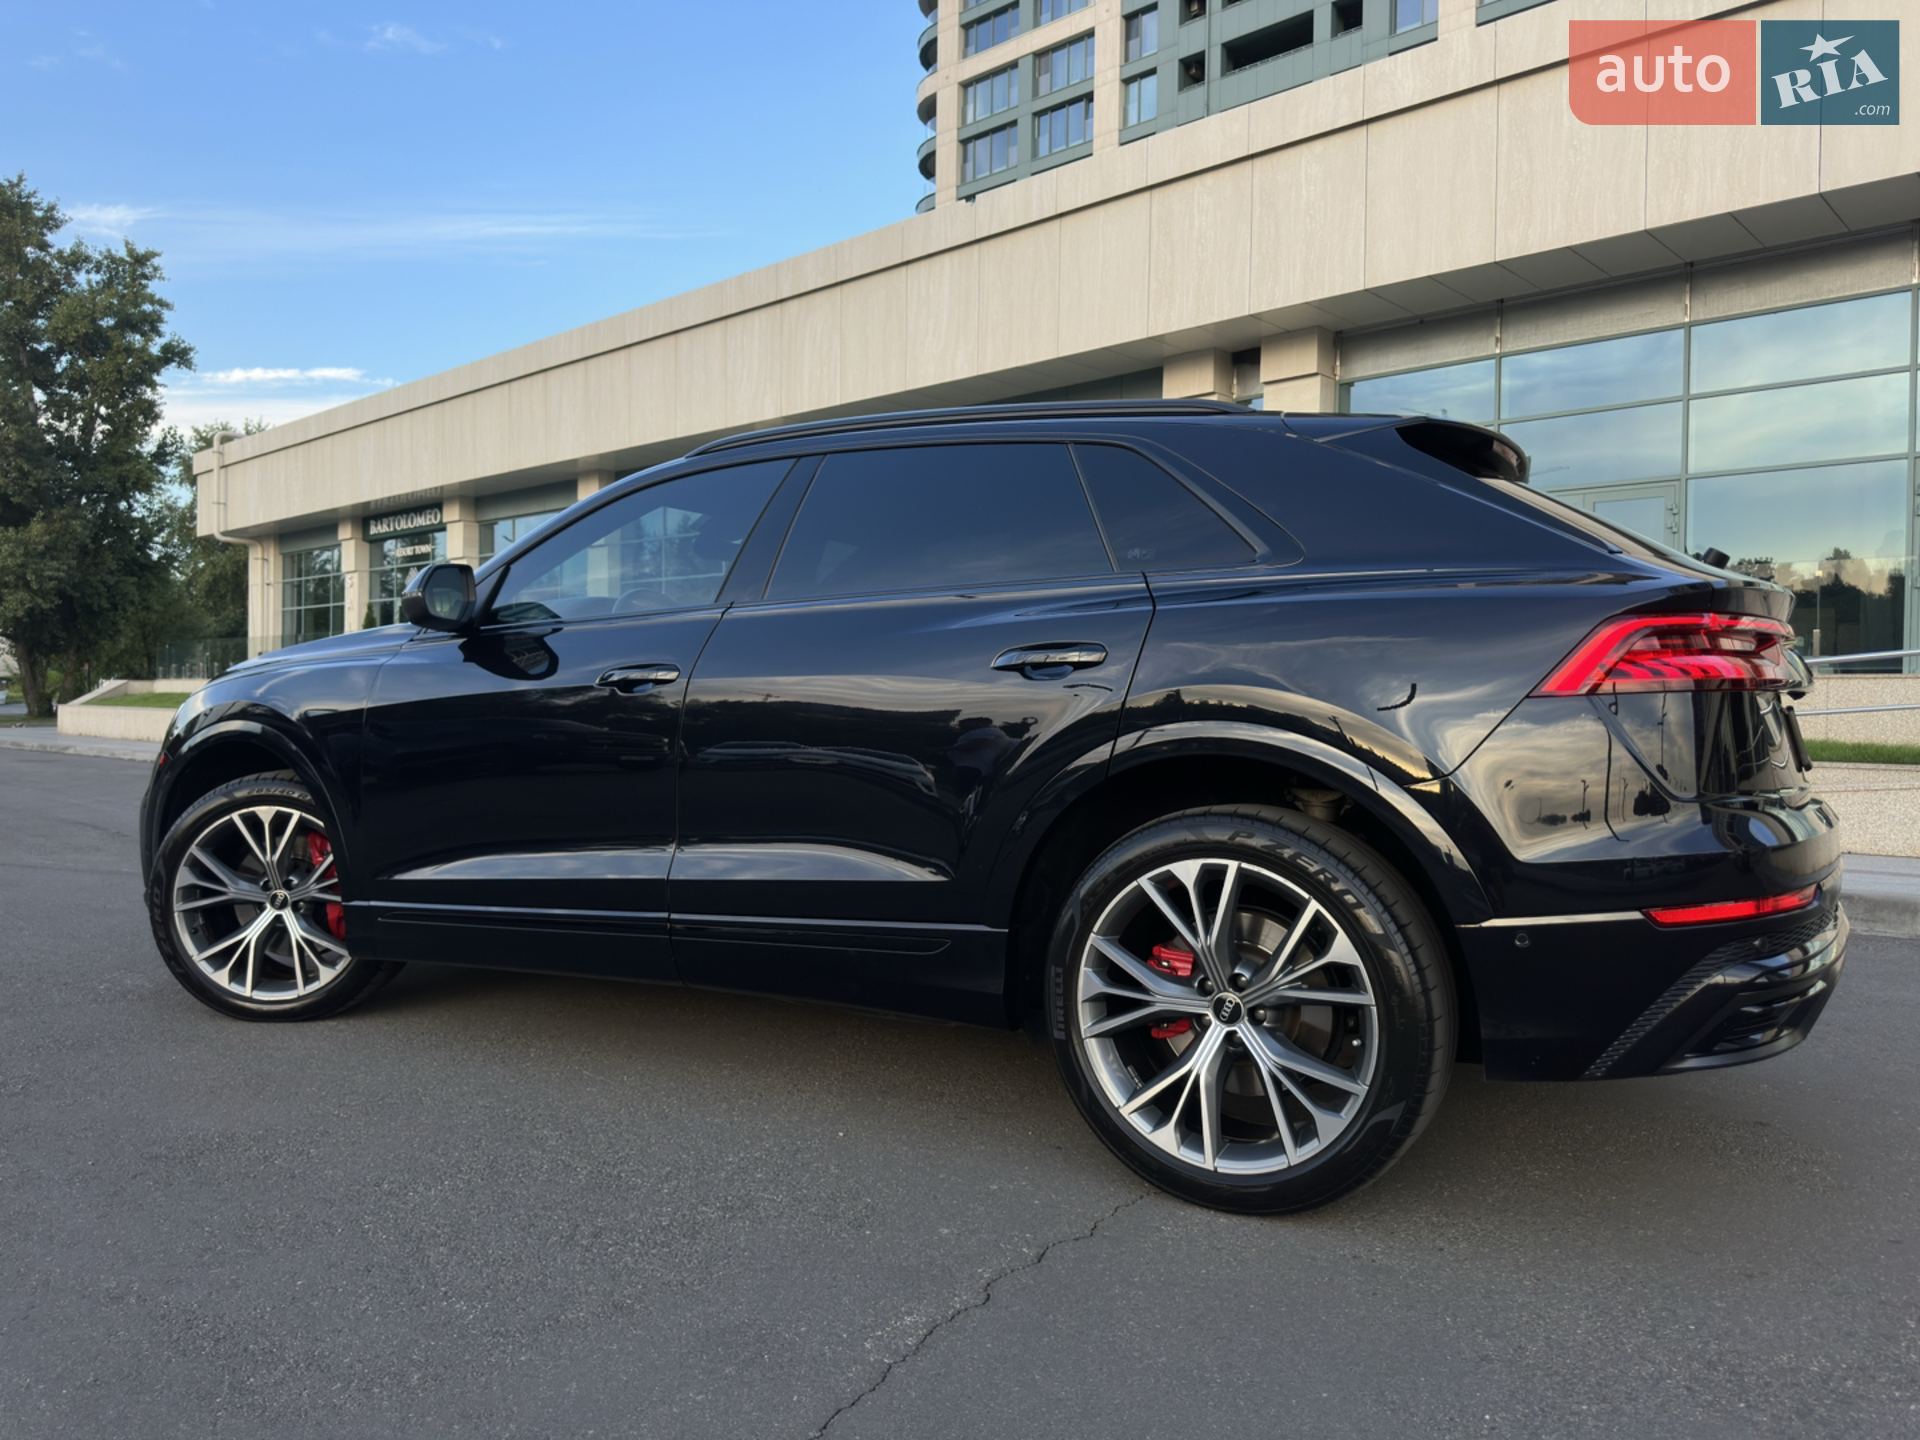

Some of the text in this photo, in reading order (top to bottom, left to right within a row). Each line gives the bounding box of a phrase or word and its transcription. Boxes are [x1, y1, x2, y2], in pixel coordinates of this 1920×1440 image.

[369, 508, 441, 535] BARTOLOMEO
[1227, 829, 1366, 910] P ZERO
[1050, 965, 1066, 1041] PIRELLI
